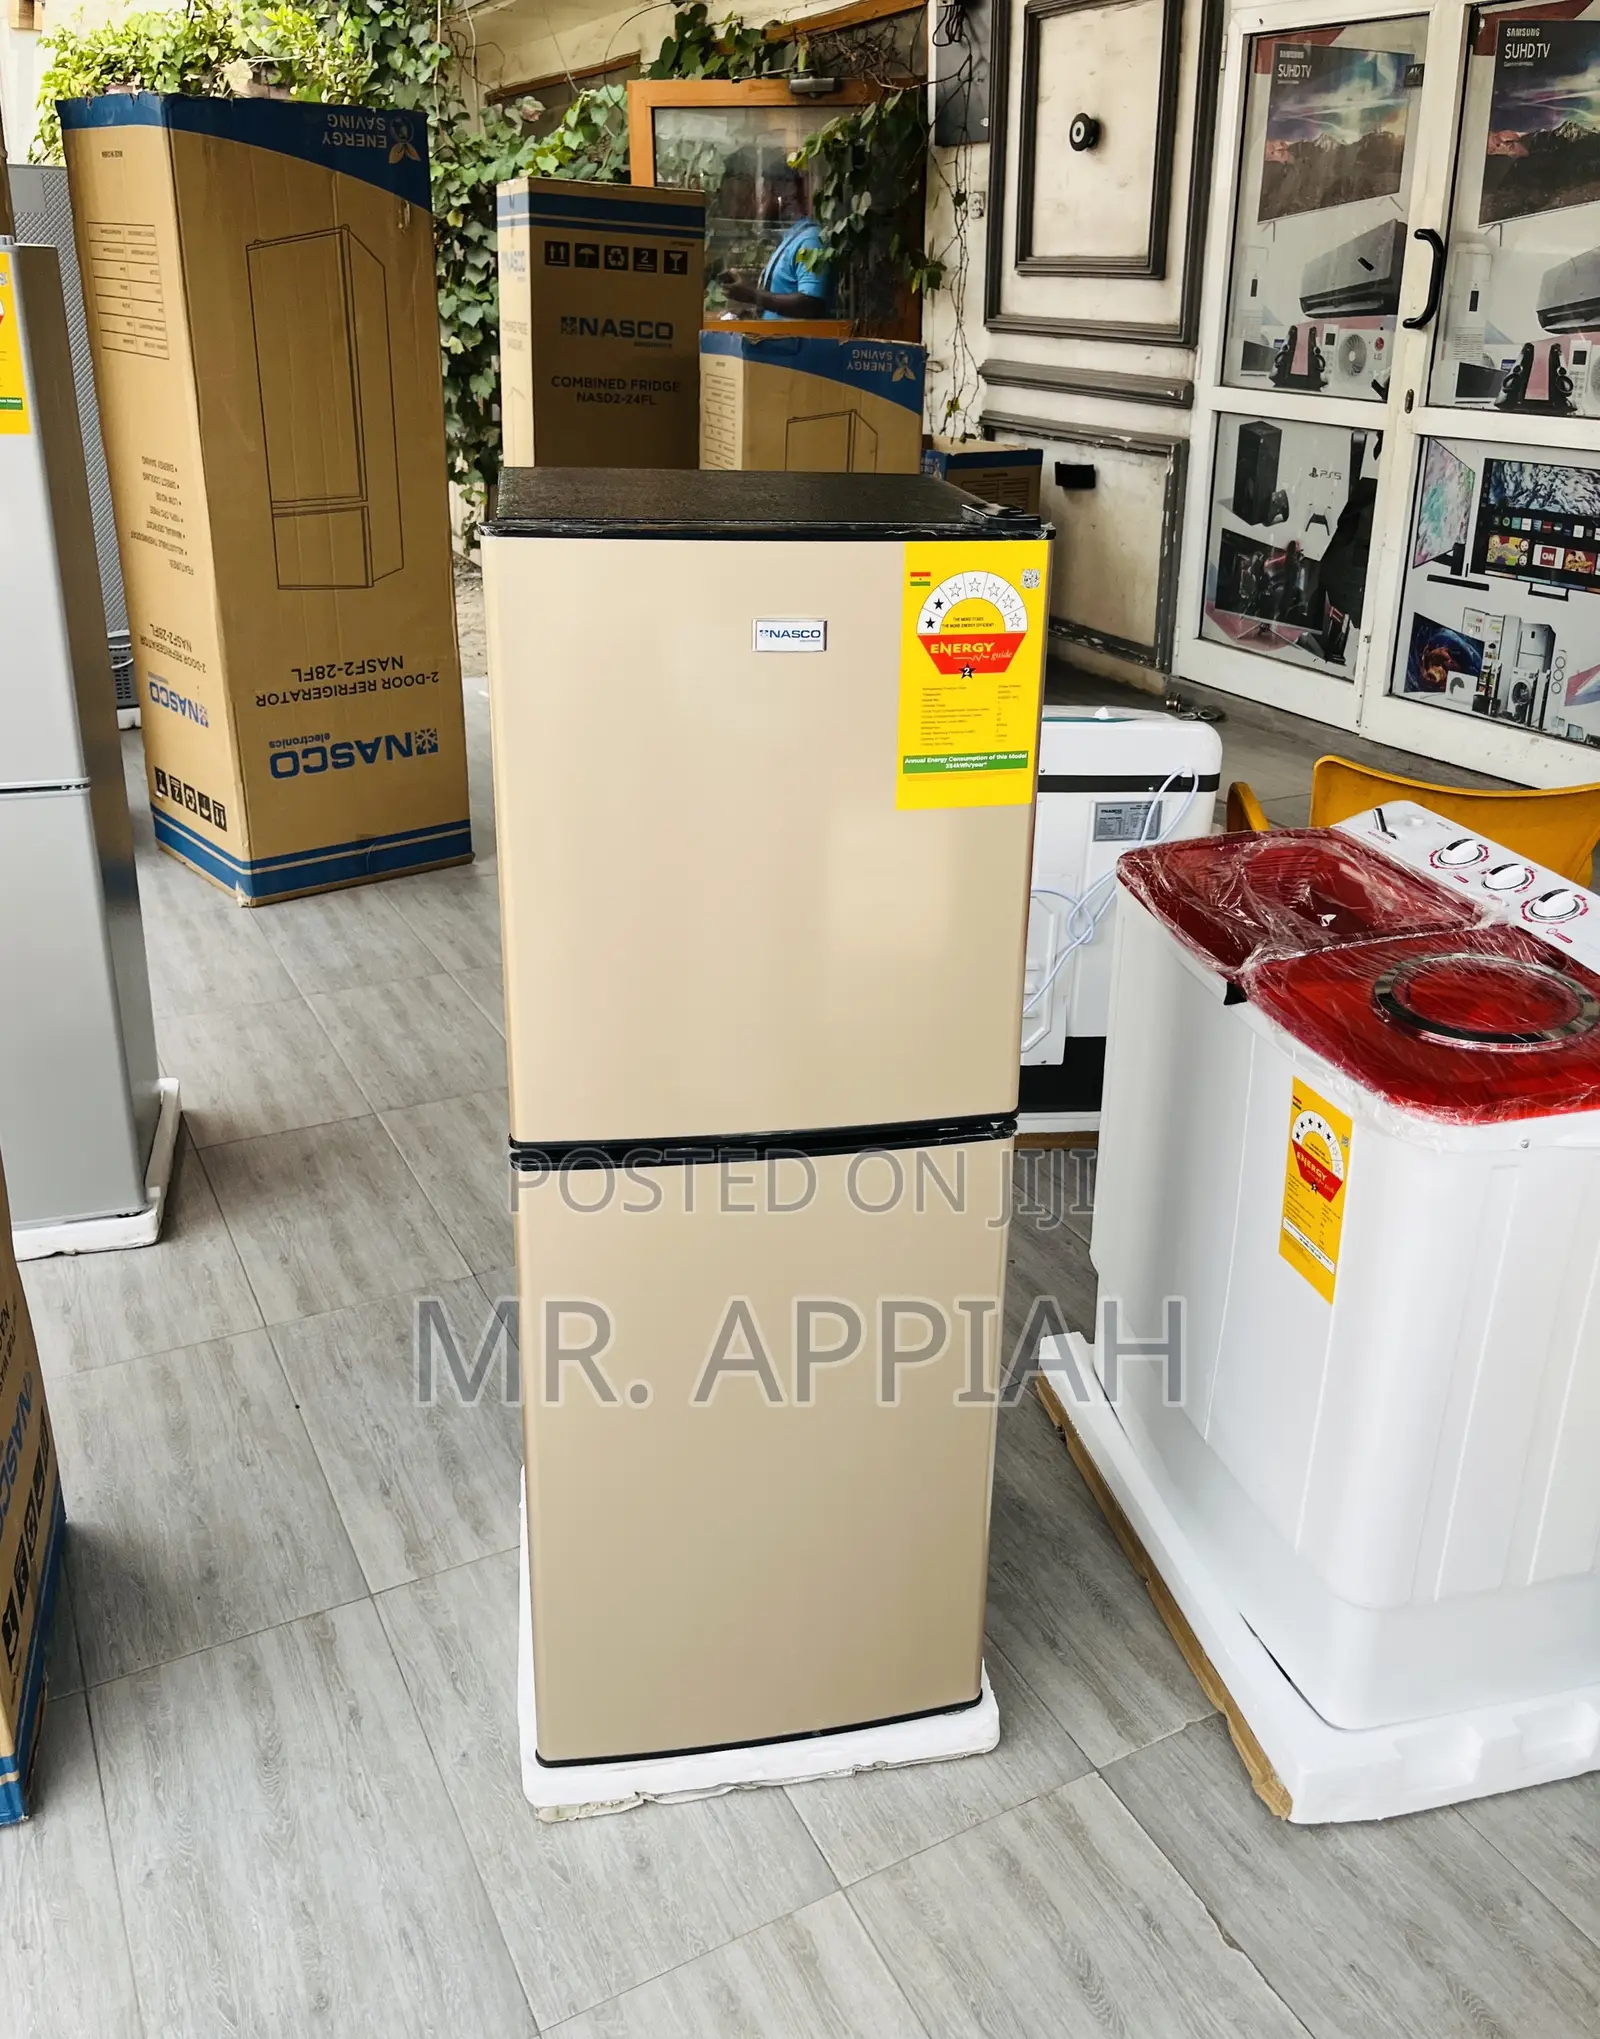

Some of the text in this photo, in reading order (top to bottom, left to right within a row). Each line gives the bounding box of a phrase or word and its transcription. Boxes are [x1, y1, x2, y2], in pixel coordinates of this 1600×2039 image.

[1506, 27, 1540, 37] SAMSUNG
[1504, 43, 1551, 59] SUHD TV
[1278, 64, 1313, 78] SUHD TV
[326, 113, 386, 131] SAVING
[322, 131, 387, 149] ENERGY
[579, 317, 674, 340] NASCO
[852, 349, 893, 361] SAVING
[847, 361, 893, 372] ENERGY
[551, 375, 681, 392] COMBINED FRIDGE
[576, 391, 657, 406] NASD2-24FL
[1320, 469, 1342, 481] PS5
[769, 629, 821, 639] NASCO
[139, 634, 207, 674] 2-DOOR REFRIGERATOR
[930, 641, 1013, 661] ENERGY guide
[291, 655, 405, 683] NASF2-28FL
[963, 667, 971, 676] 2
[255, 671, 440, 707] 2-DOOR REFRIGERATOR
[149, 681, 199, 724] NASCO
[268, 732, 331, 749] electronics
[269, 731, 413, 779] NASCO
[926, 756, 948, 764] Energy
[948, 755, 988, 763] Consumption
[1296, 1151, 1328, 1181] ENERGY
